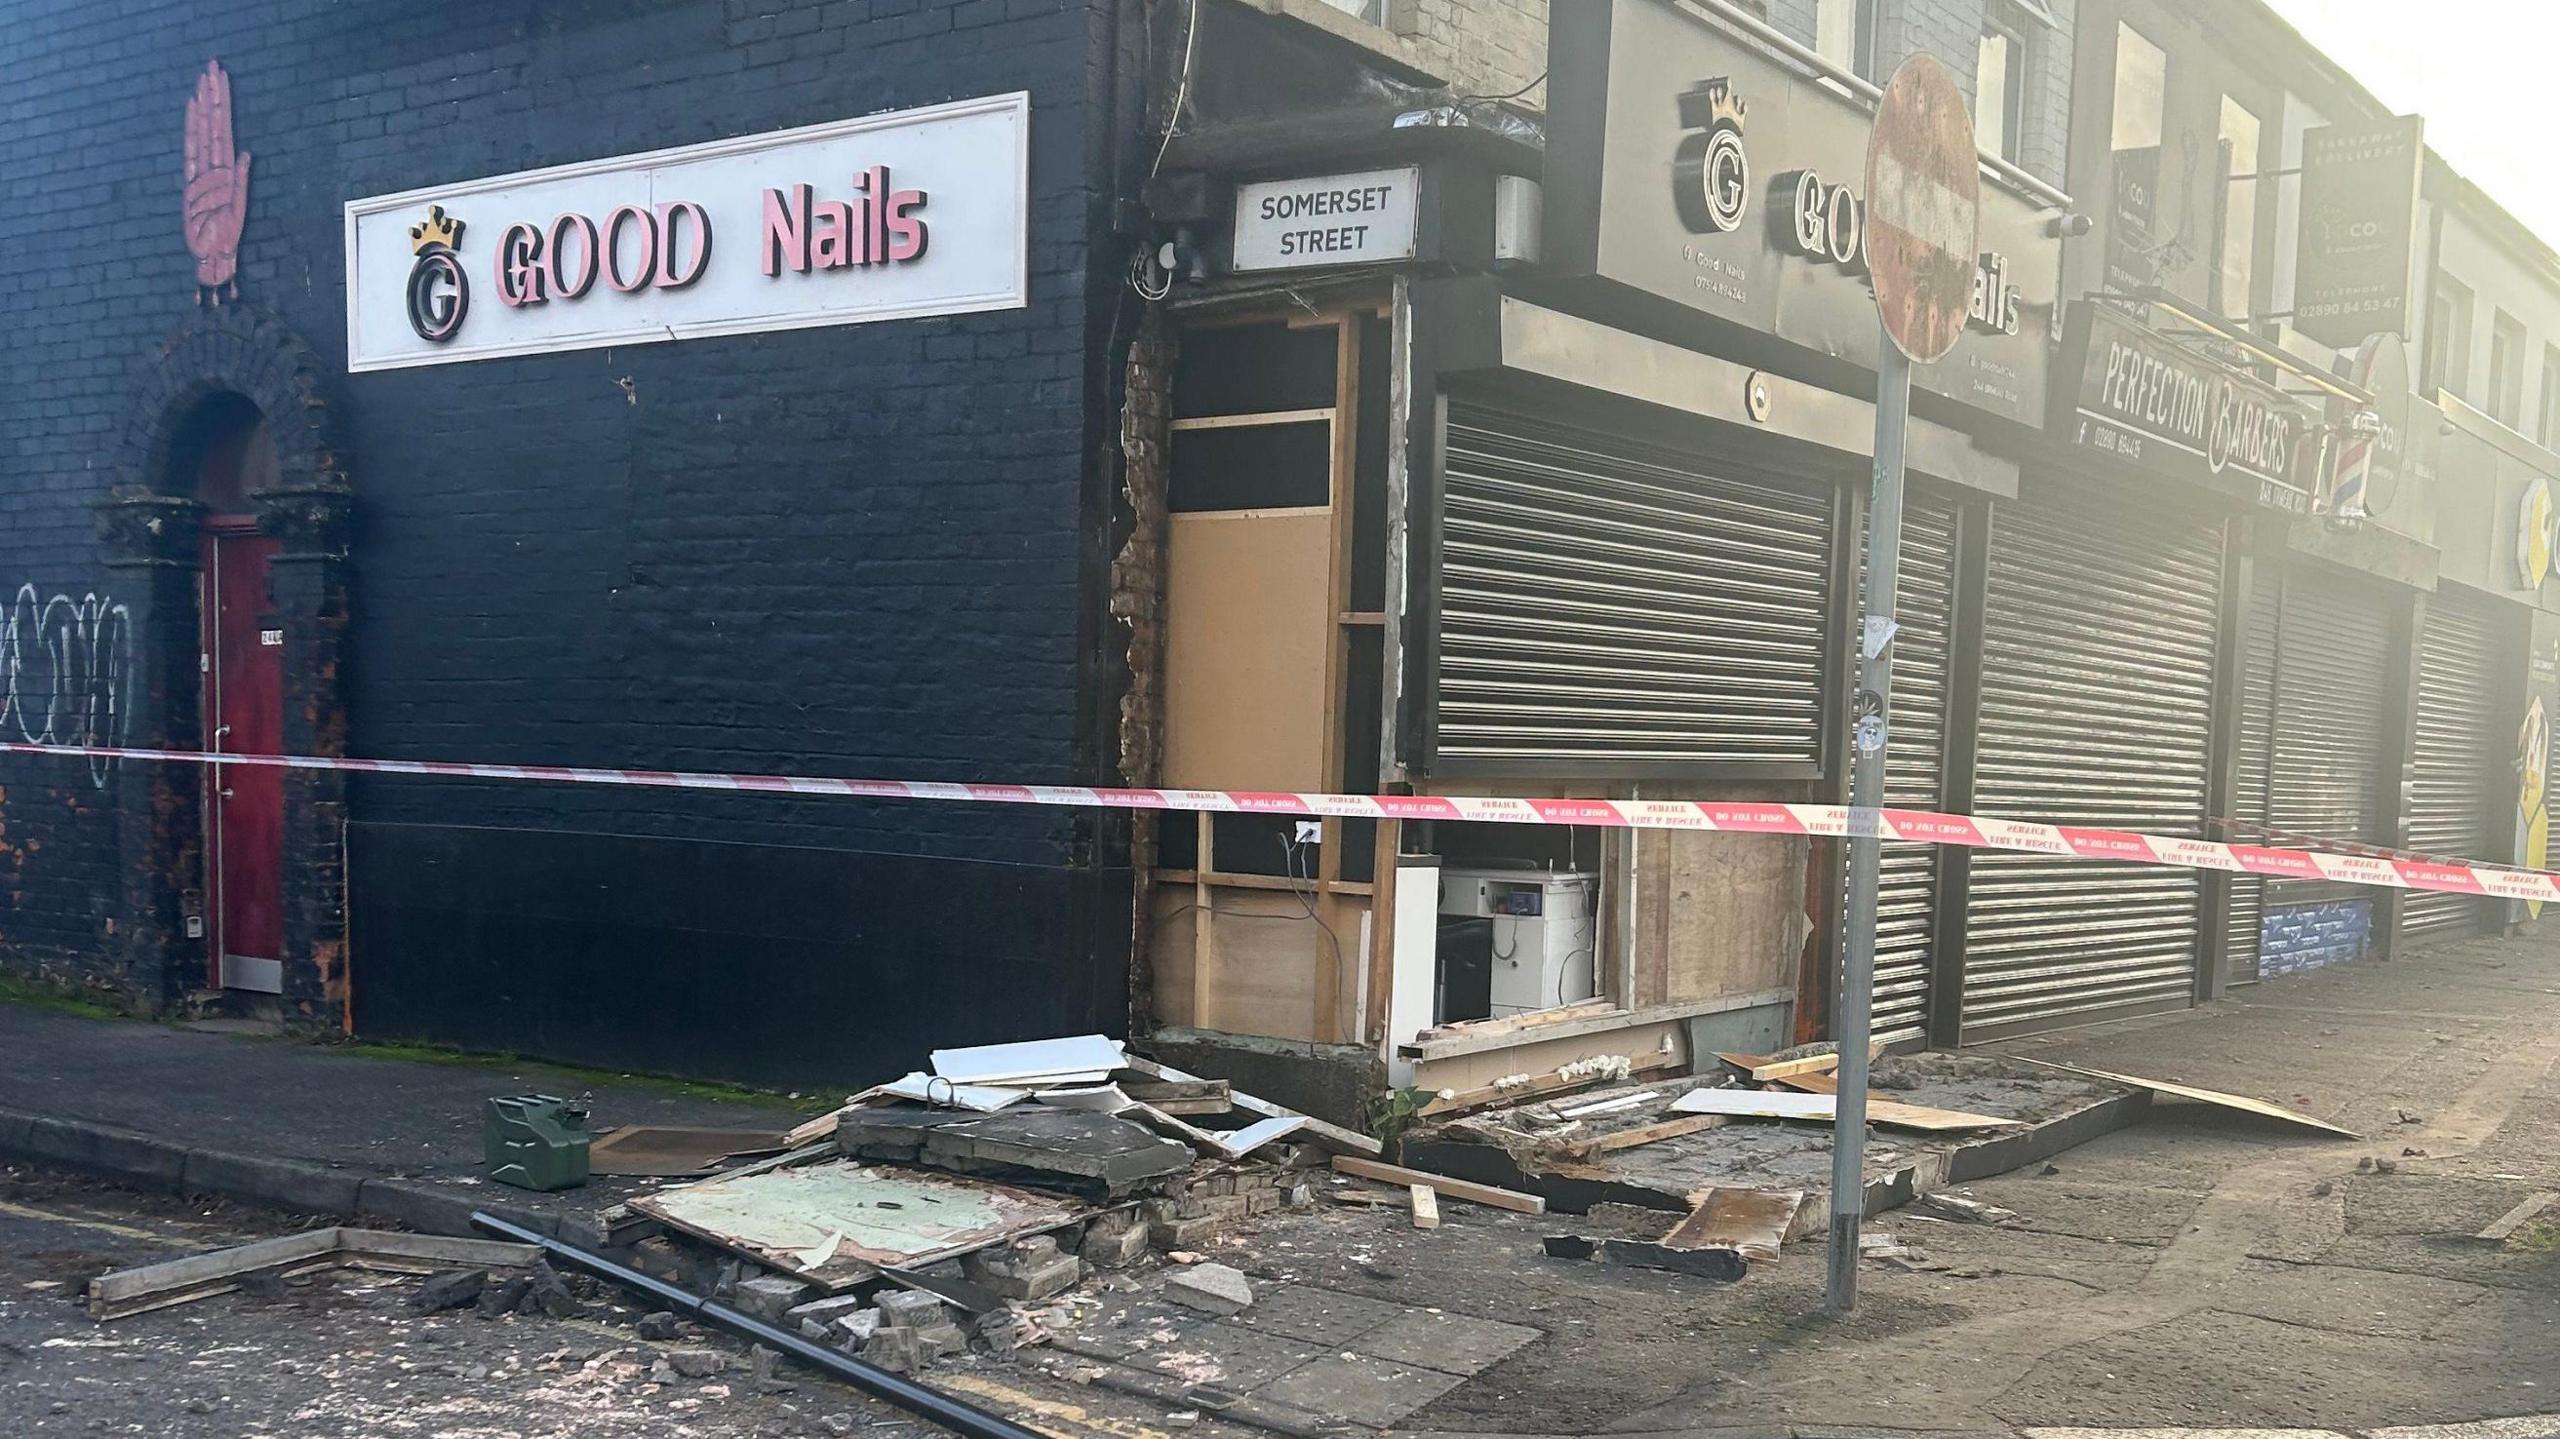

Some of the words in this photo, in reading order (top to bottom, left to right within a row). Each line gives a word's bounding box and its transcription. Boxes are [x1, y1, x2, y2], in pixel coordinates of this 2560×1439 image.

[1260, 186, 1392, 221] SOMERSET
[494, 199, 713, 308] GOOD
[761, 165, 929, 277] Nails
[1280, 225, 1369, 255] STREET
[1697, 252, 1719, 271] Good
[1724, 262, 1745, 281] Nails
[1968, 251, 2021, 336] ails
[2101, 341, 2209, 440] PERFECTION
[2208, 380, 2290, 475] BARBERS
